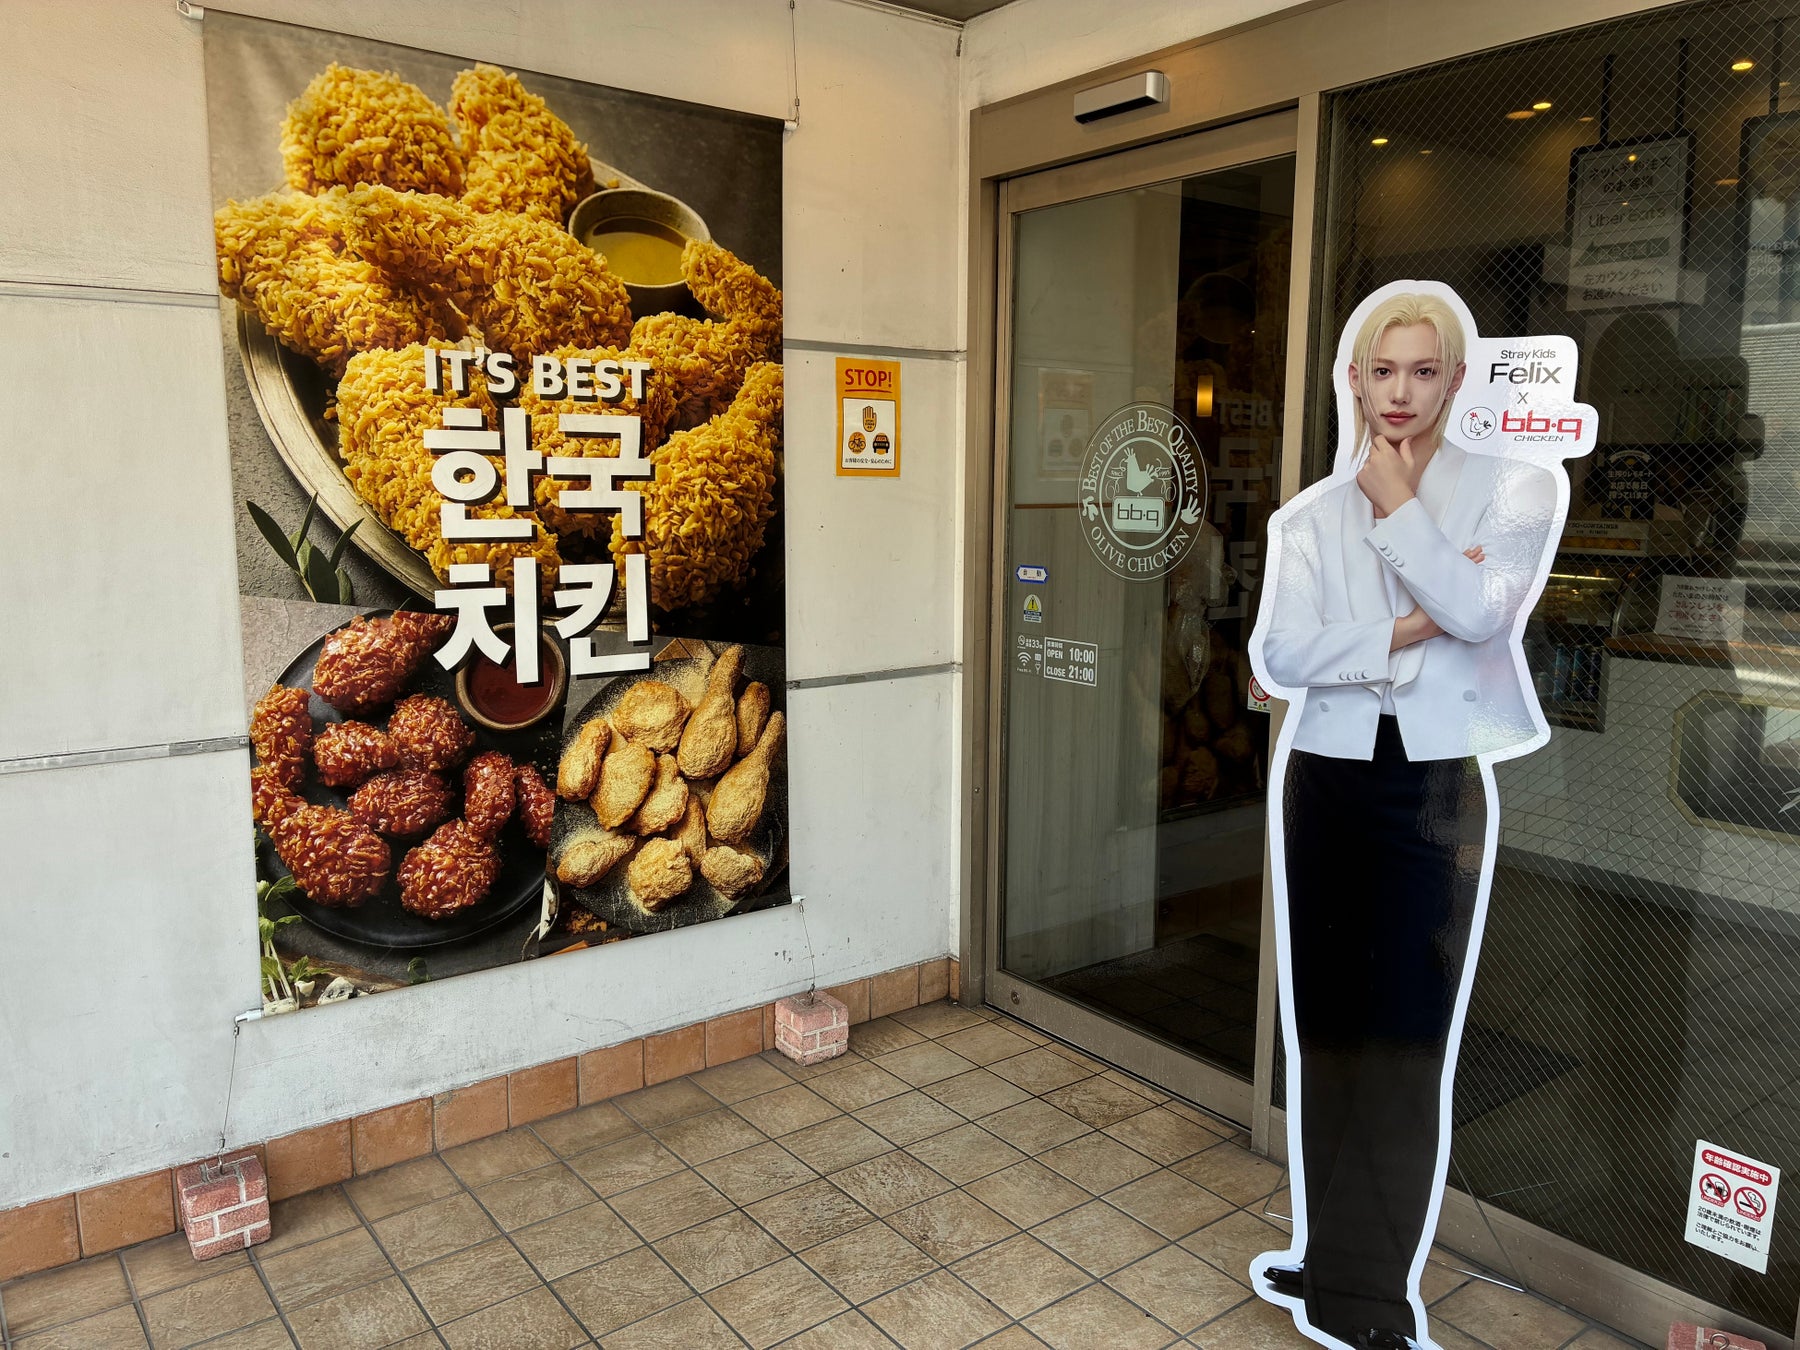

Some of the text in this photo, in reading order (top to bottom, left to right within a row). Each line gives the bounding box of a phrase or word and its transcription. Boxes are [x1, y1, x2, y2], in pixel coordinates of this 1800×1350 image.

[1588, 213, 1623, 229] Uber
[1500, 348, 1556, 361] Stray Kids
[424, 346, 650, 400] IT'S BEST
[845, 368, 892, 388] STOP!
[1489, 361, 1563, 385] Felix
[1513, 435, 1564, 443] CHICKEN
[1082, 410, 1199, 494] BEST OF THE BEST QUALITY
[423, 407, 651, 539] 한국
[1091, 526, 1190, 573] OLIVE CHICKEN
[433, 554, 650, 684] 치킨
[1046, 647, 1095, 664] OPEN 10:00
[1046, 664, 1094, 682] CLOSE 21:00
[1704, 1152, 1769, 1183] 年齢確認実施中
[1695, 1228, 1725, 1244] いたします。
[1696, 1211, 1760, 1241] 法律で禁じられています。
